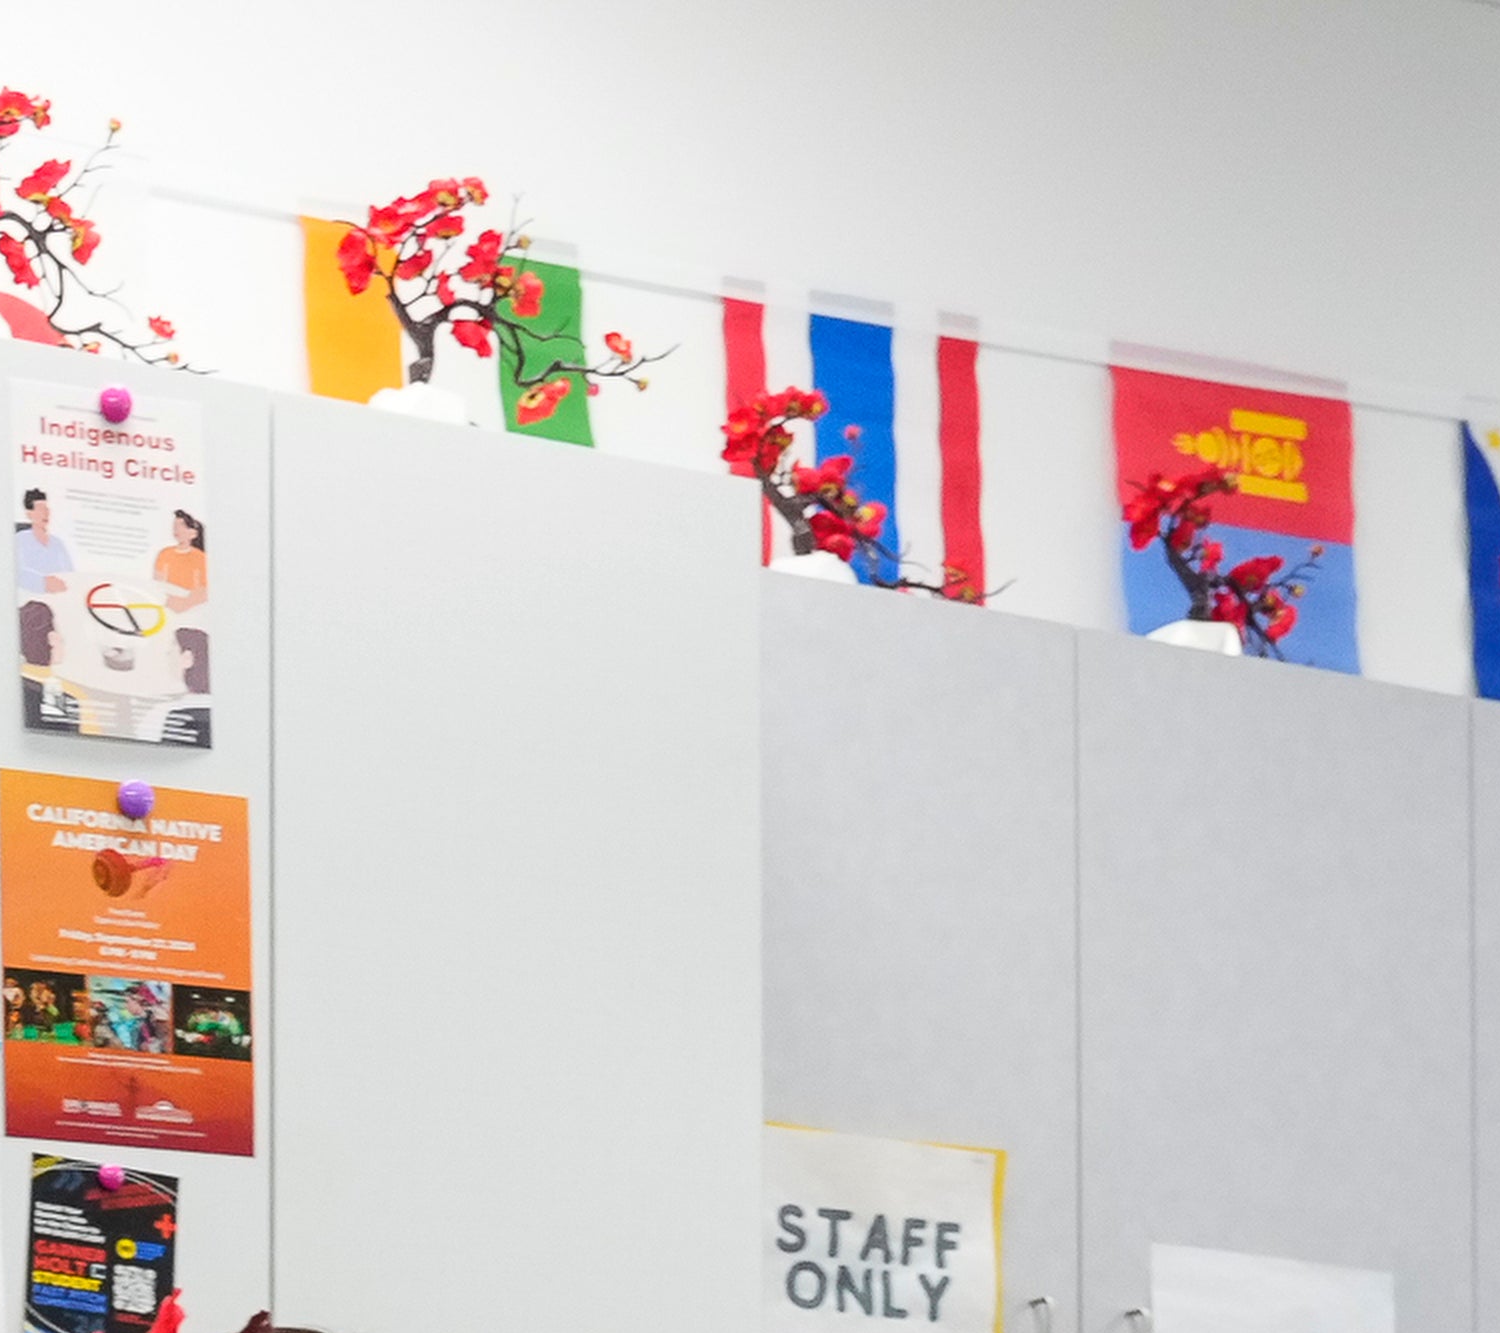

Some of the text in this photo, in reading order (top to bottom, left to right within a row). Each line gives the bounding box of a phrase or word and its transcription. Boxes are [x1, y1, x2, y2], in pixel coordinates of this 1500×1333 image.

[39, 416, 177, 453] Indigenous
[20, 444, 197, 485] Healing Circle
[25, 802, 223, 843] CALIFORNIA NATIVE
[51, 829, 199, 863] AMERICAN DAY
[775, 1203, 961, 1269] STAFF
[785, 1259, 951, 1322] ONLY
